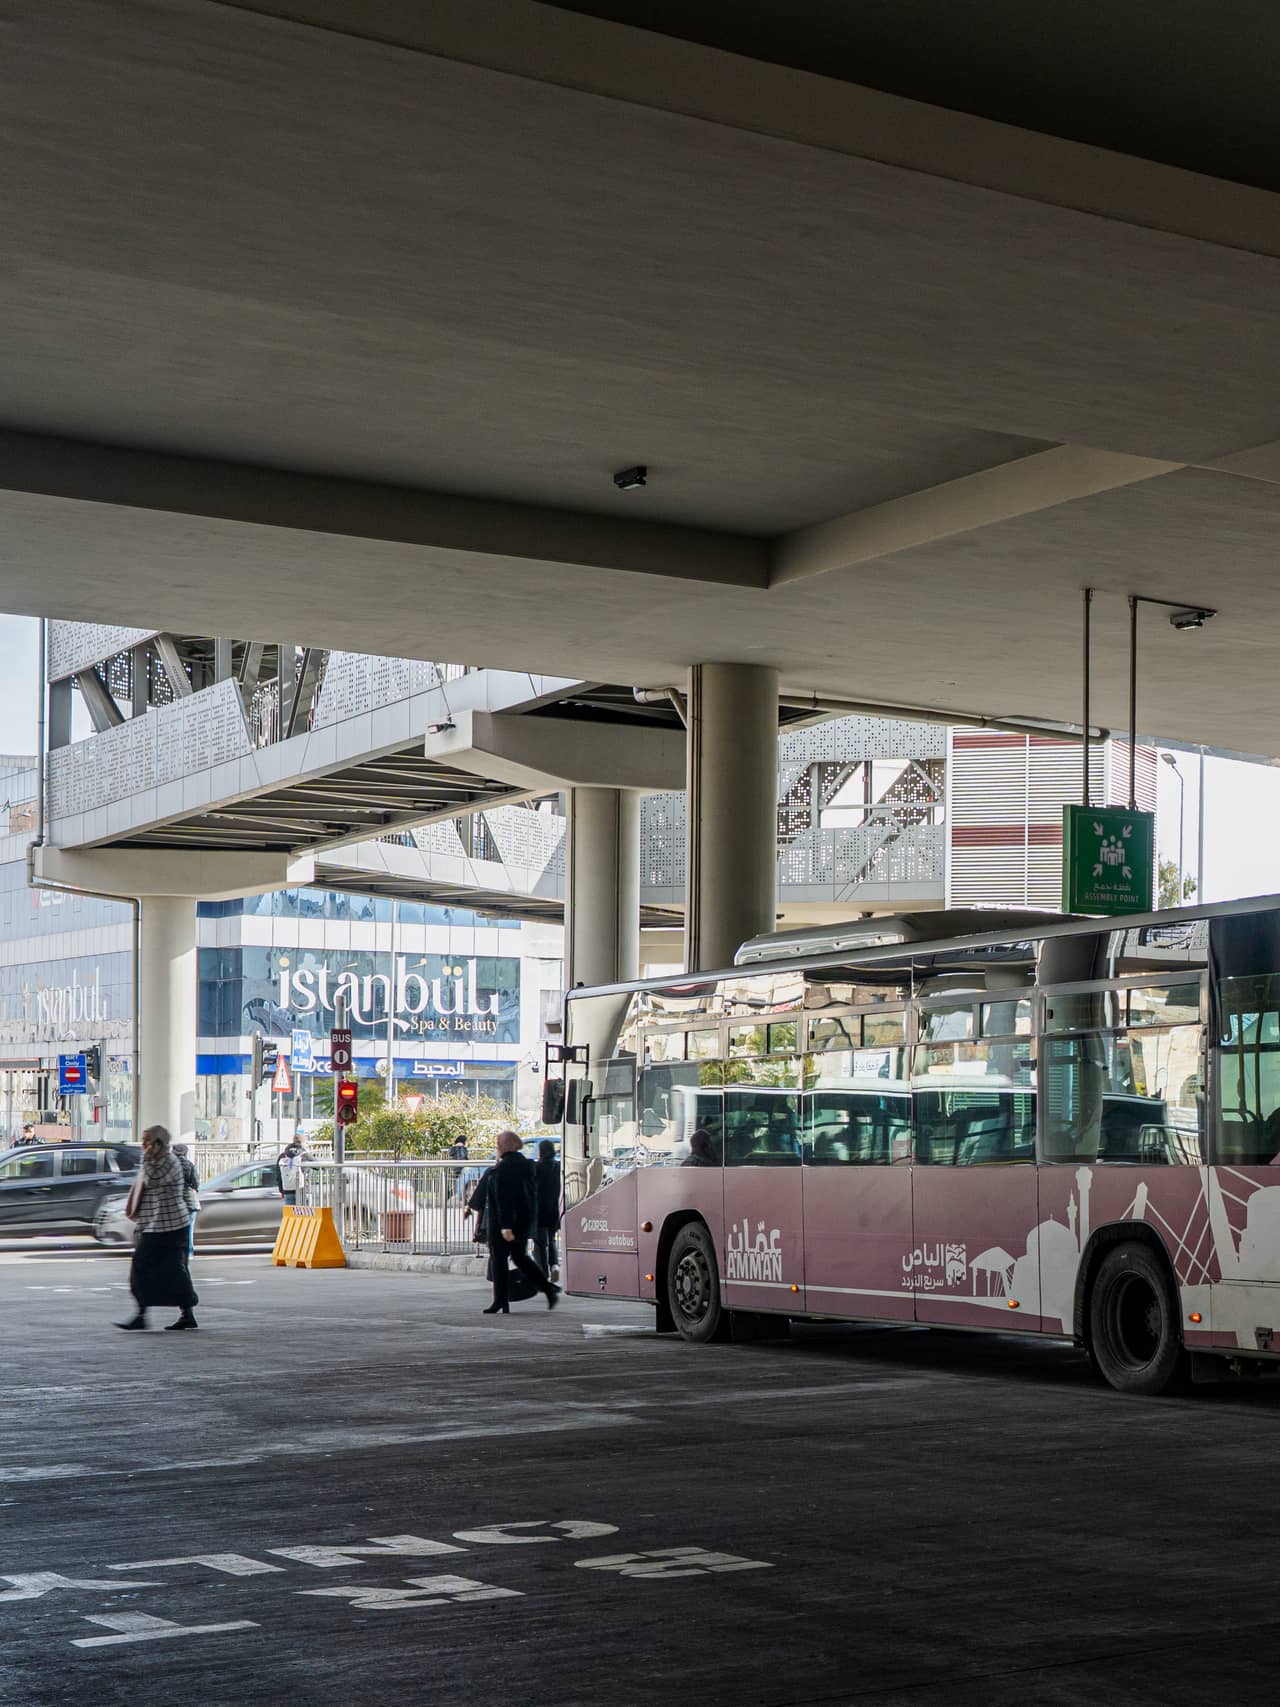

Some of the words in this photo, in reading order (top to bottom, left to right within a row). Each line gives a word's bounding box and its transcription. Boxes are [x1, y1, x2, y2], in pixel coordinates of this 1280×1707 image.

[1085, 891, 1118, 902] ASSEMBLY
[1119, 894, 1139, 904] POINT
[410, 1016, 435, 1035] Spa
[439, 1016, 449, 1031] &
[454, 1016, 498, 1035] Beauty
[332, 1033, 351, 1042] BUS
[412, 1060, 465, 1075] المحيط
[608, 1234, 634, 1247] autobus
[902, 1242, 944, 1273] الباص
[726, 1251, 783, 1281] AMMAN
[901, 1273, 923, 1289] التردد
[923, 1273, 944, 1290] سريع
